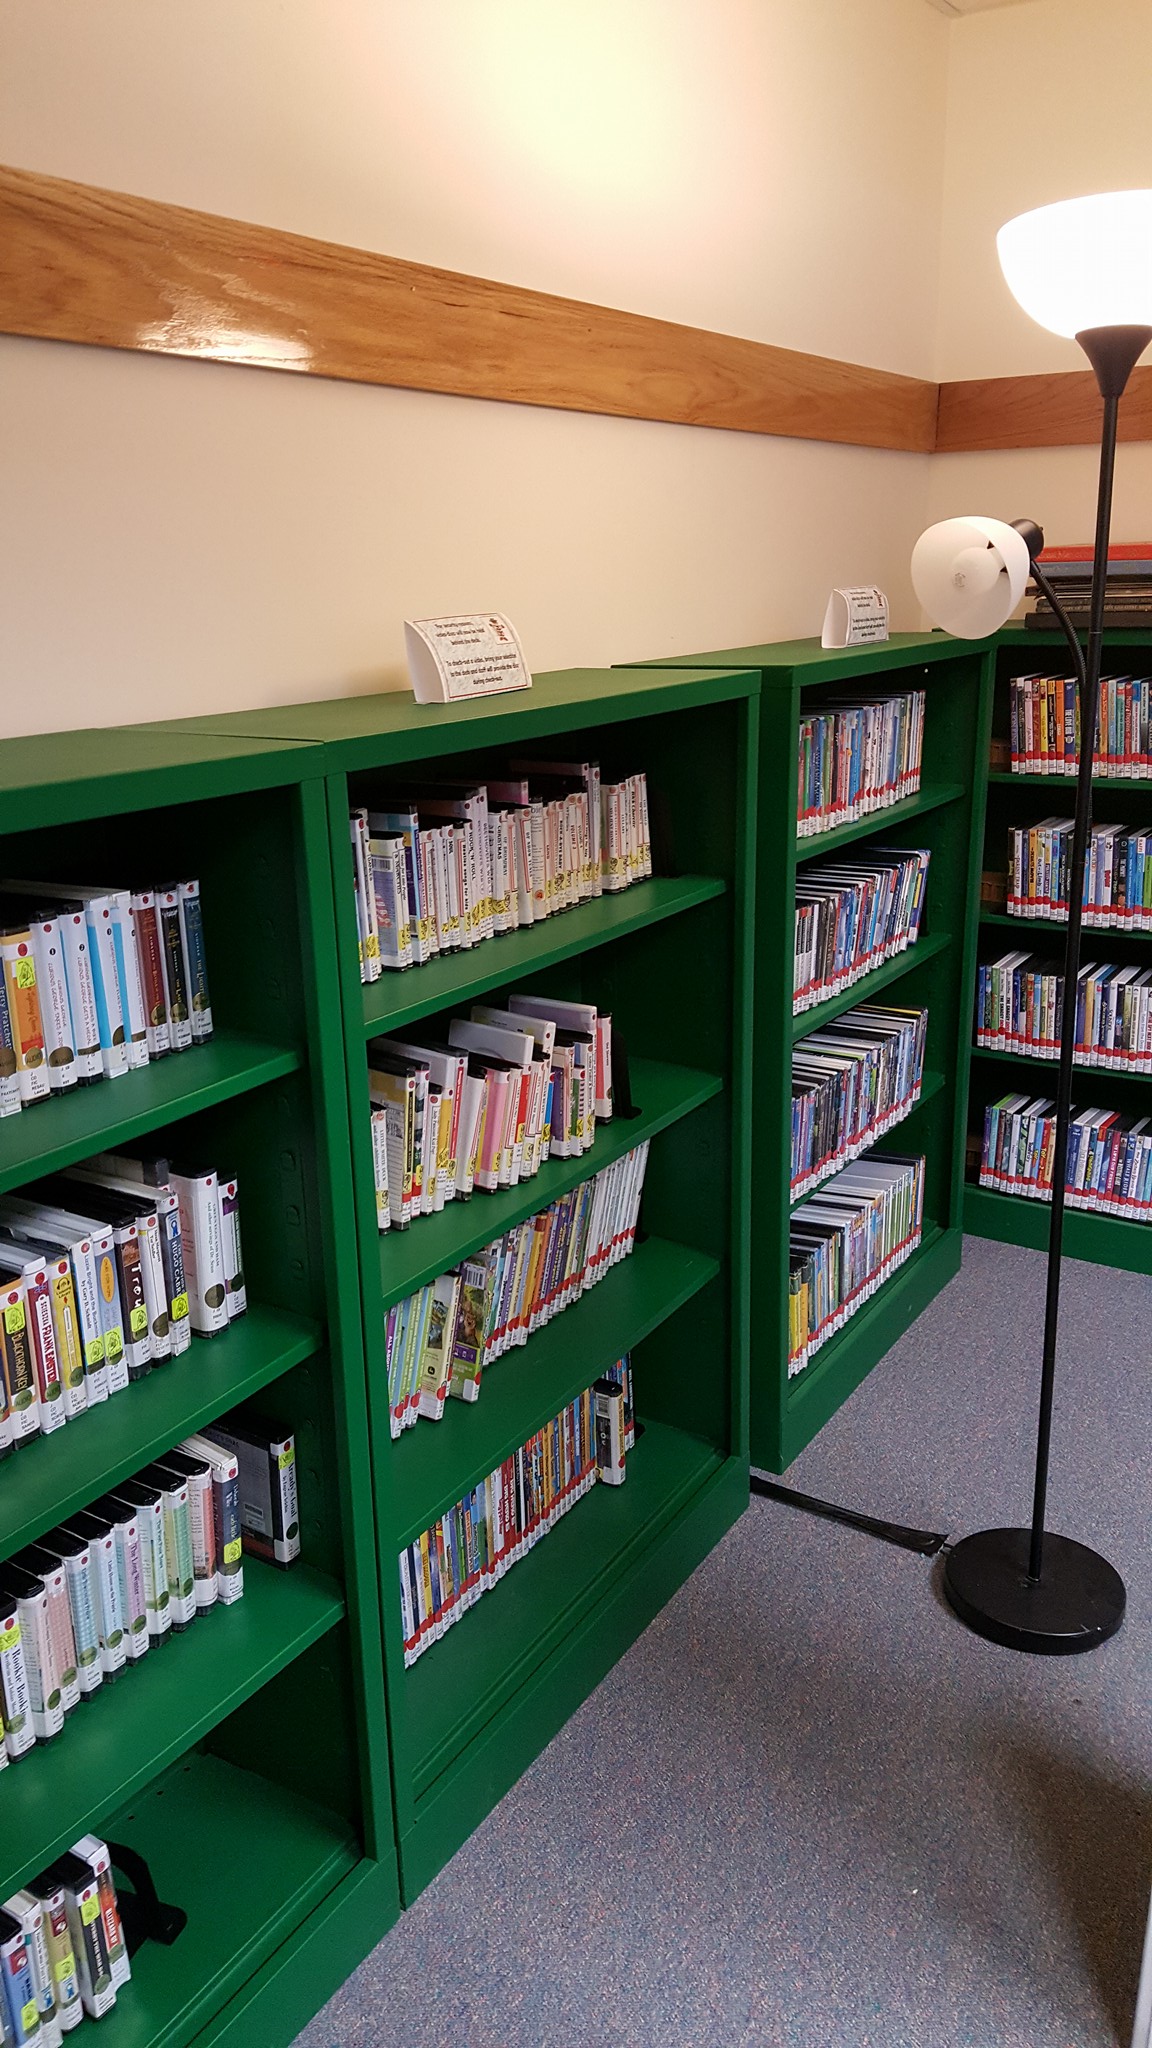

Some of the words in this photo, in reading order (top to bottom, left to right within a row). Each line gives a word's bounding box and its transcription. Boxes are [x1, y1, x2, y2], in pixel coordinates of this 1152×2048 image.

[170, 1241, 180, 1266] HUGO
[173, 1268, 183, 1297] CABR
[39, 1301, 50, 1325] SCIESZKA
[83, 1308, 92, 1328] Schmidt
[41, 1325, 53, 1351] FRANK
[12, 1333, 26, 1376] BLACKTHORN
[17, 1376, 27, 1390] KEY
[289, 1497, 298, 1515] Goal
[128, 1543, 137, 1556] The
[130, 1557, 139, 1573] Long
[132, 1573, 141, 1594] Winter
[11, 1649, 24, 1681] Rookie
[16, 1684, 29, 1714] Booki
[94, 1953, 104, 1966] WAR
